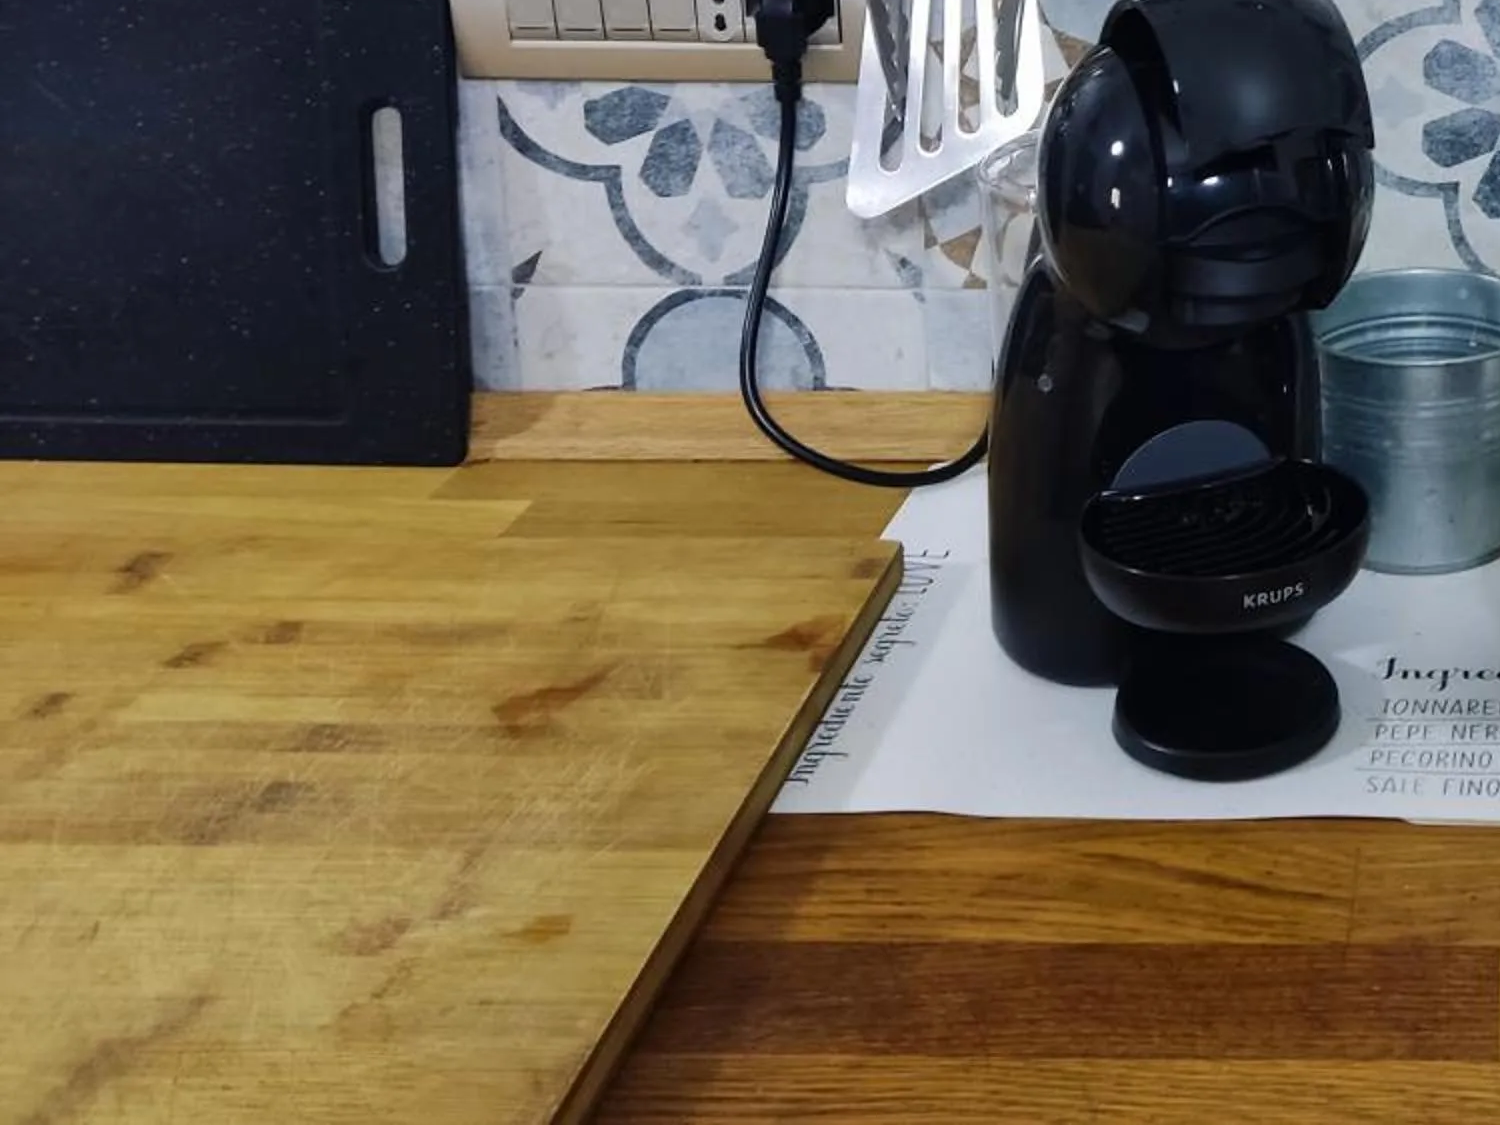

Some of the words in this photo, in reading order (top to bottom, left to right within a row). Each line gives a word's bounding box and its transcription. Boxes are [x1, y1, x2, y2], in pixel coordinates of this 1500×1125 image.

[1243, 582, 1304, 609] KRUPS
[1370, 749, 1493, 769] PECORINO
[1443, 778, 1500, 798] FINO
